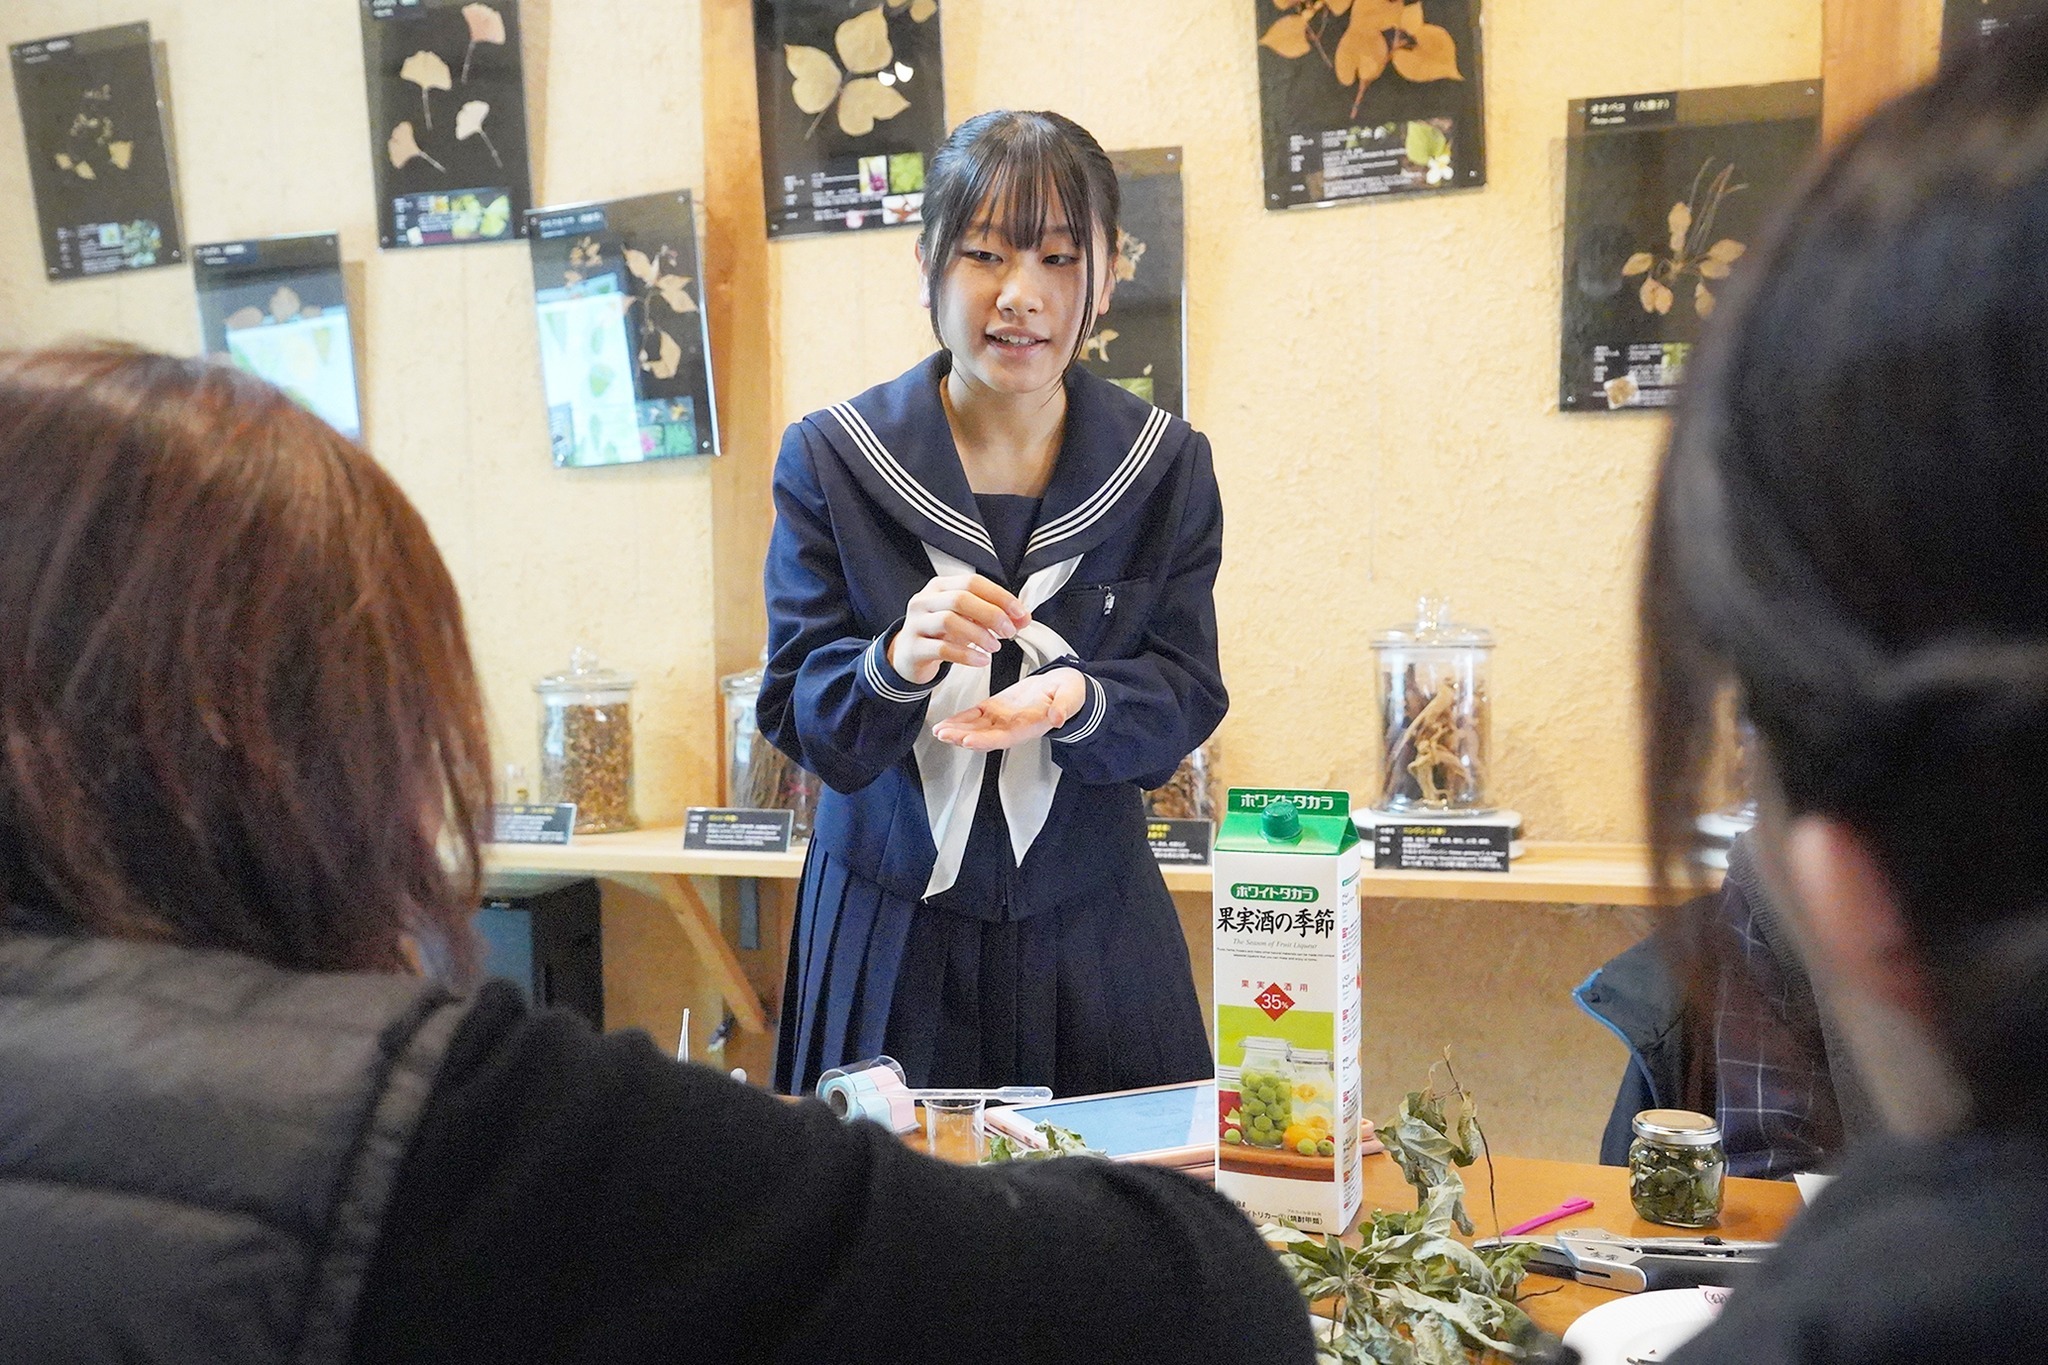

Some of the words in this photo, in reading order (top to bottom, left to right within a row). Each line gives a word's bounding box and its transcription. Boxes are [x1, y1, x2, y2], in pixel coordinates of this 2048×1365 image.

[1236, 886, 1314, 901] ホワイトタカラ
[1216, 906, 1335, 939] 果実酒の季節
[1246, 938, 1266, 946] Season
[1293, 942, 1318, 950] Liqueur
[1261, 993, 1289, 1010] 35%
